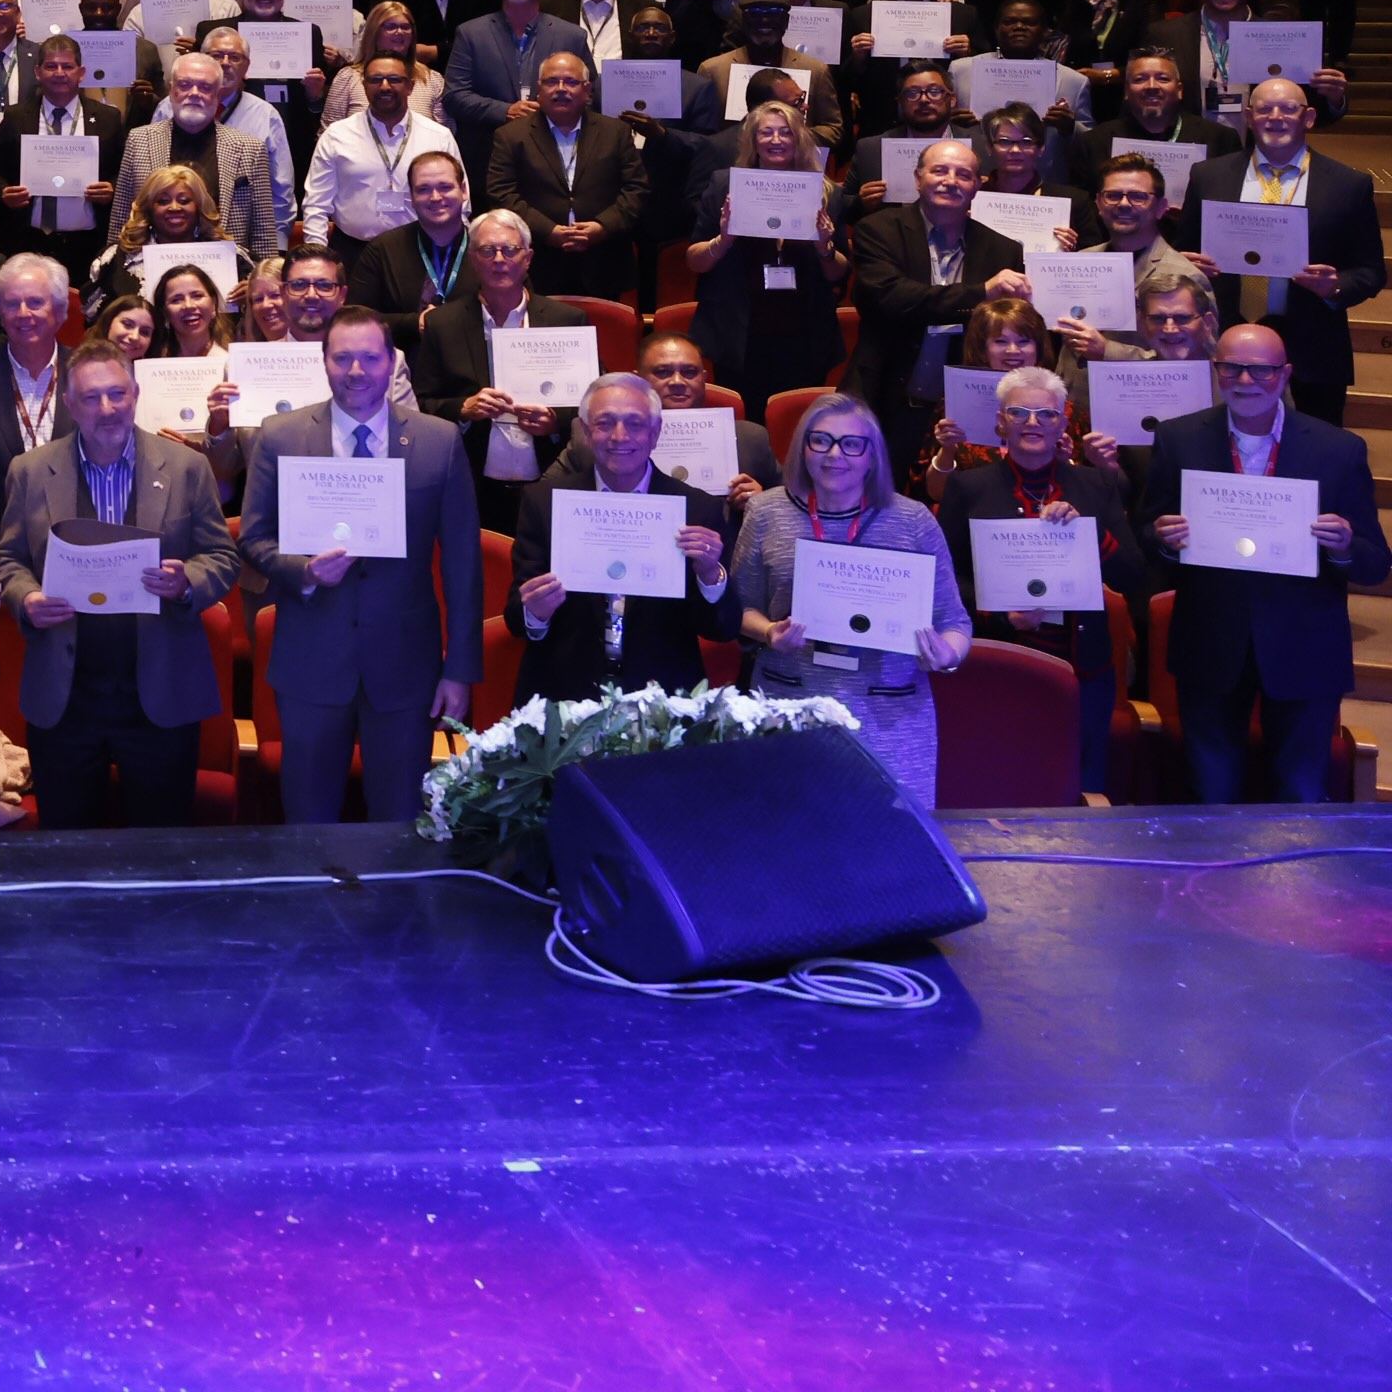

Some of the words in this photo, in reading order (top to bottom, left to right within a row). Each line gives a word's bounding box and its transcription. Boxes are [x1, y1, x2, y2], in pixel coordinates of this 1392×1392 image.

[885, 9, 938, 17] AMBASSADOR
[986, 202, 1054, 213] AMBASSADOR
[1015, 209, 1039, 217] ISRAEL
[1040, 265, 1113, 274] AMBASSADOR
[510, 340, 580, 349] AMBASSADOR
[1381, 336, 1391, 348] 6
[245, 357, 320, 365] AMBASSADOR
[151, 369, 217, 377] AMBASSADOR
[1107, 374, 1189, 382] AMBASSADOR
[1142, 379, 1173, 387] ISRAEL
[299, 472, 384, 484] AMBASSADOR
[335, 481, 367, 489] ISRAEL
[1200, 487, 1292, 503] AMBASSADOR
[1217, 496, 1233, 504] FOR
[1239, 498, 1272, 506] ISRAEL
[572, 507, 662, 521] AMBASSADOR
[590, 516, 606, 524] FOR
[612, 518, 644, 527] ISRAEL
[992, 532, 1076, 541] AMBASSADOR
[816, 559, 911, 579] AMBASSADOR
[834, 570, 850, 578] FOR
[856, 572, 891, 583] ISRAEL
